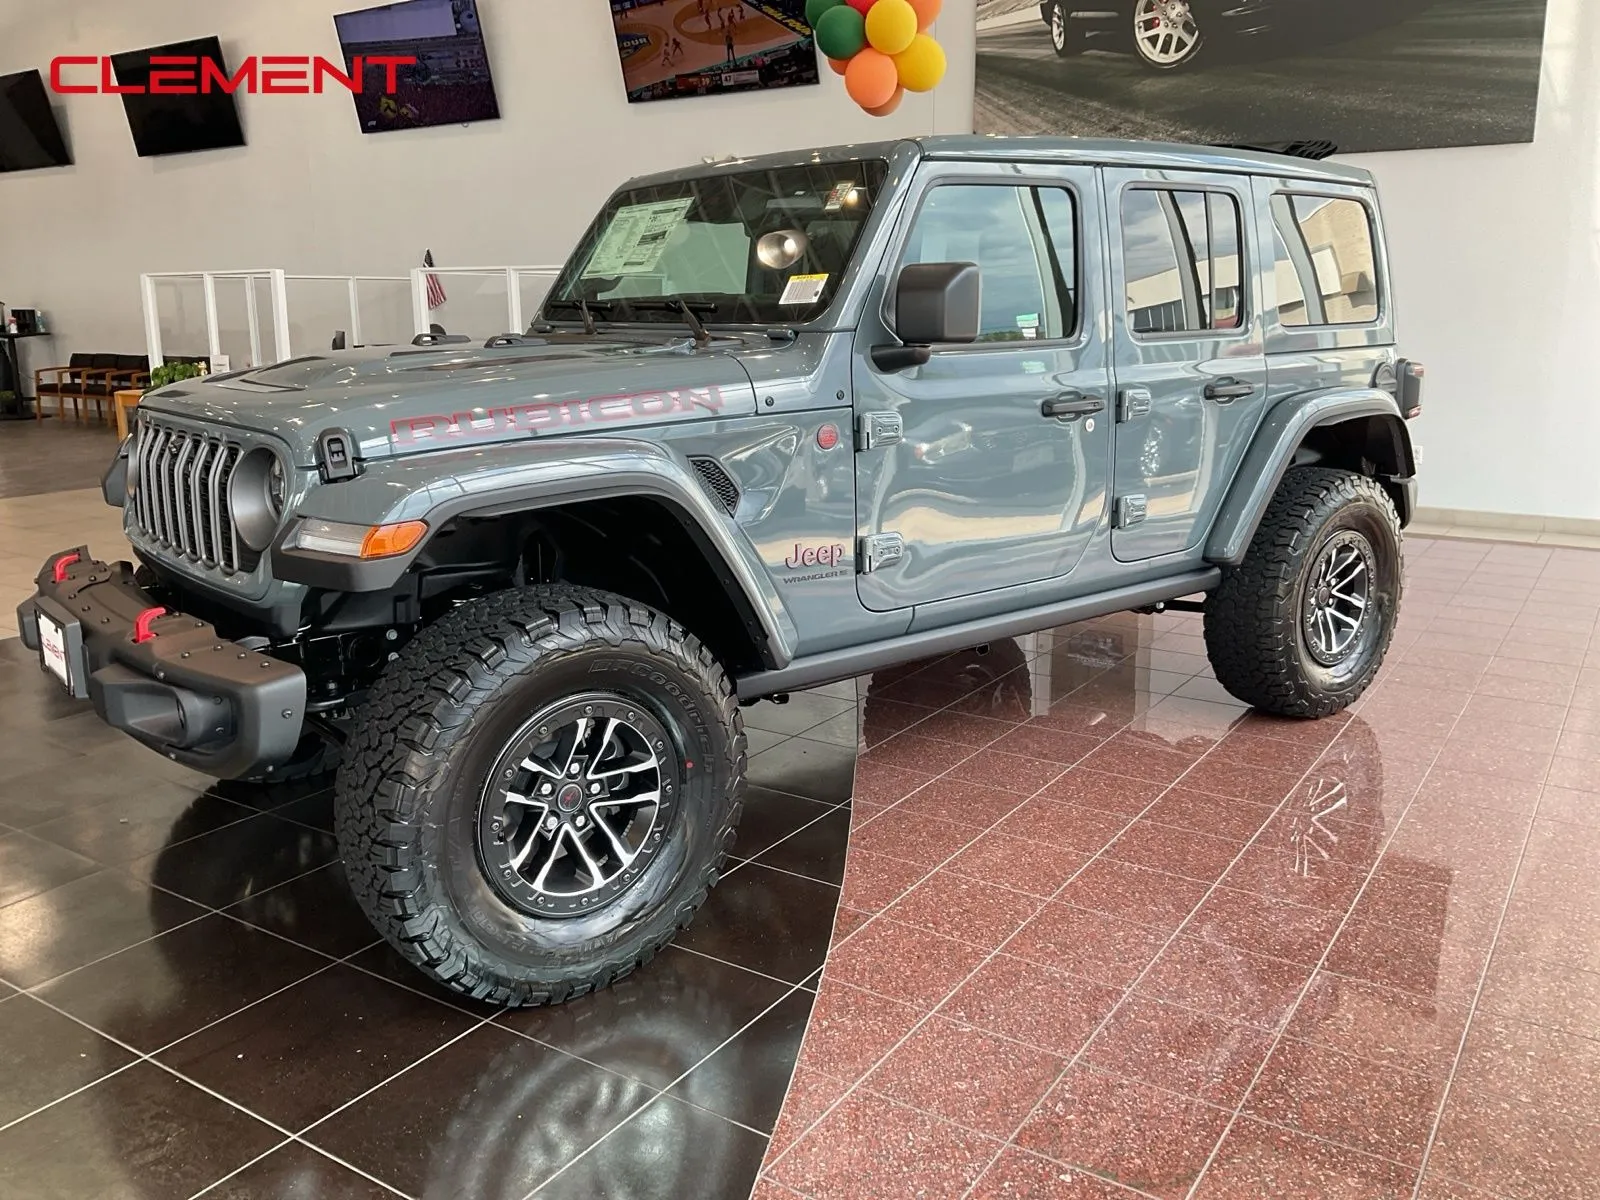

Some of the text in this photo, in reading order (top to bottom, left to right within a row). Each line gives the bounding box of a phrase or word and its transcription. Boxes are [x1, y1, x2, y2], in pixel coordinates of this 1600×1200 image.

[390, 386, 723, 443] RUBICON
[785, 543, 845, 569] Jeep
[783, 570, 838, 584] WRANGLER
